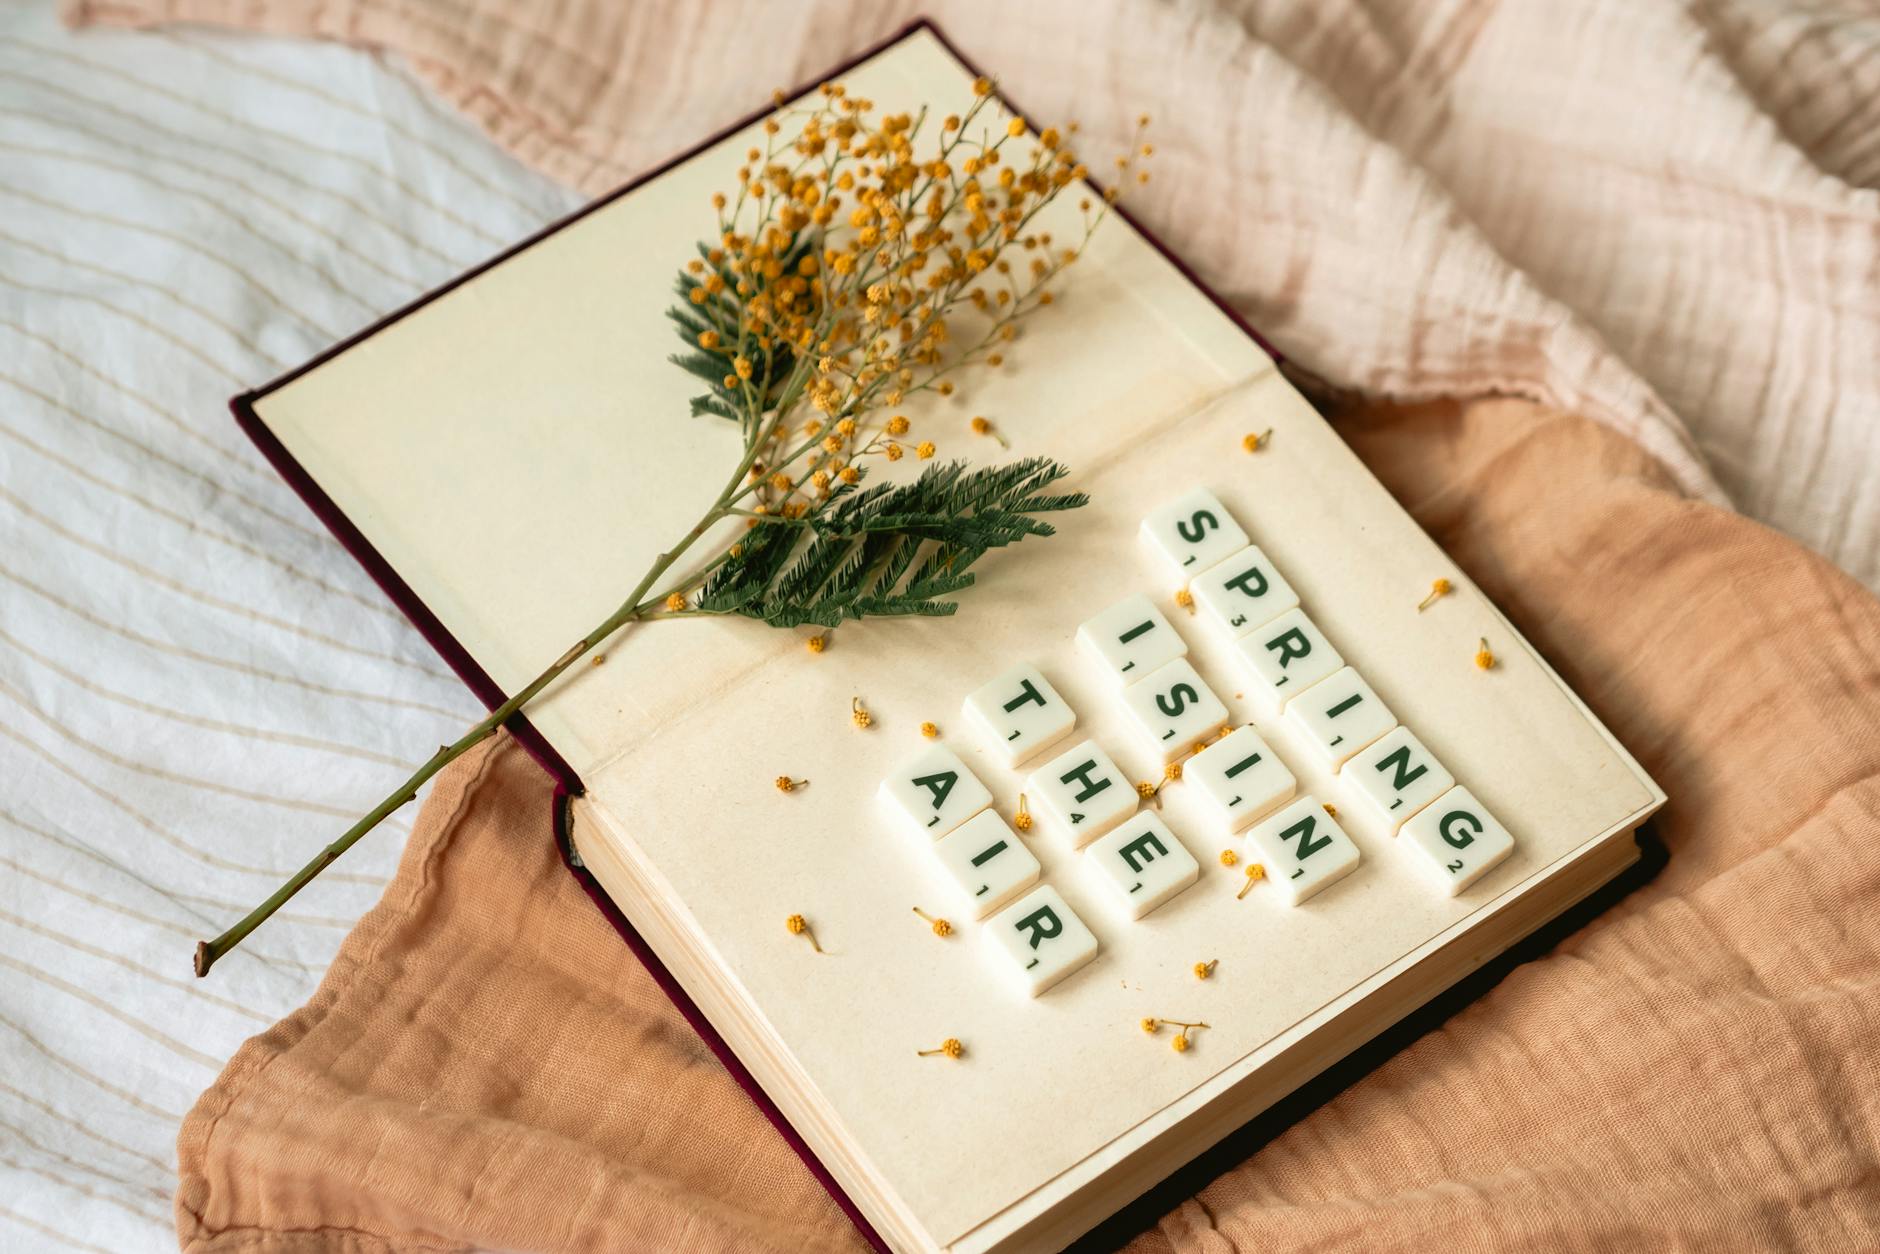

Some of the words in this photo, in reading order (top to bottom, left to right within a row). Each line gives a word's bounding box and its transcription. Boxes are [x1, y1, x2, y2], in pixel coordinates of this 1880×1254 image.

[1183, 555, 1196, 566] 1
[1230, 614, 1247, 627] 3
[1118, 619, 1199, 718] IS
[1121, 661, 1135, 672] 1
[1177, 509, 1484, 850] SPRING
[1275, 676, 1289, 687] 1
[1007, 729, 1021, 741] 1
[1162, 729, 1176, 741] 1
[1330, 735, 1344, 747] 1
[1002, 678, 1169, 874] THE
[1224, 752, 1333, 861] IN
[1228, 795, 1243, 807] 1
[1389, 798, 1403, 810] 1
[927, 815, 941, 828] 1
[1070, 813, 1086, 824] 4
[911, 770, 1063, 951] AIR
[1447, 859, 1464, 874] 2
[1291, 868, 1305, 880] 1
[976, 884, 990, 897] 1
[1129, 882, 1143, 894] 1
[1026, 958, 1040, 970] 1
